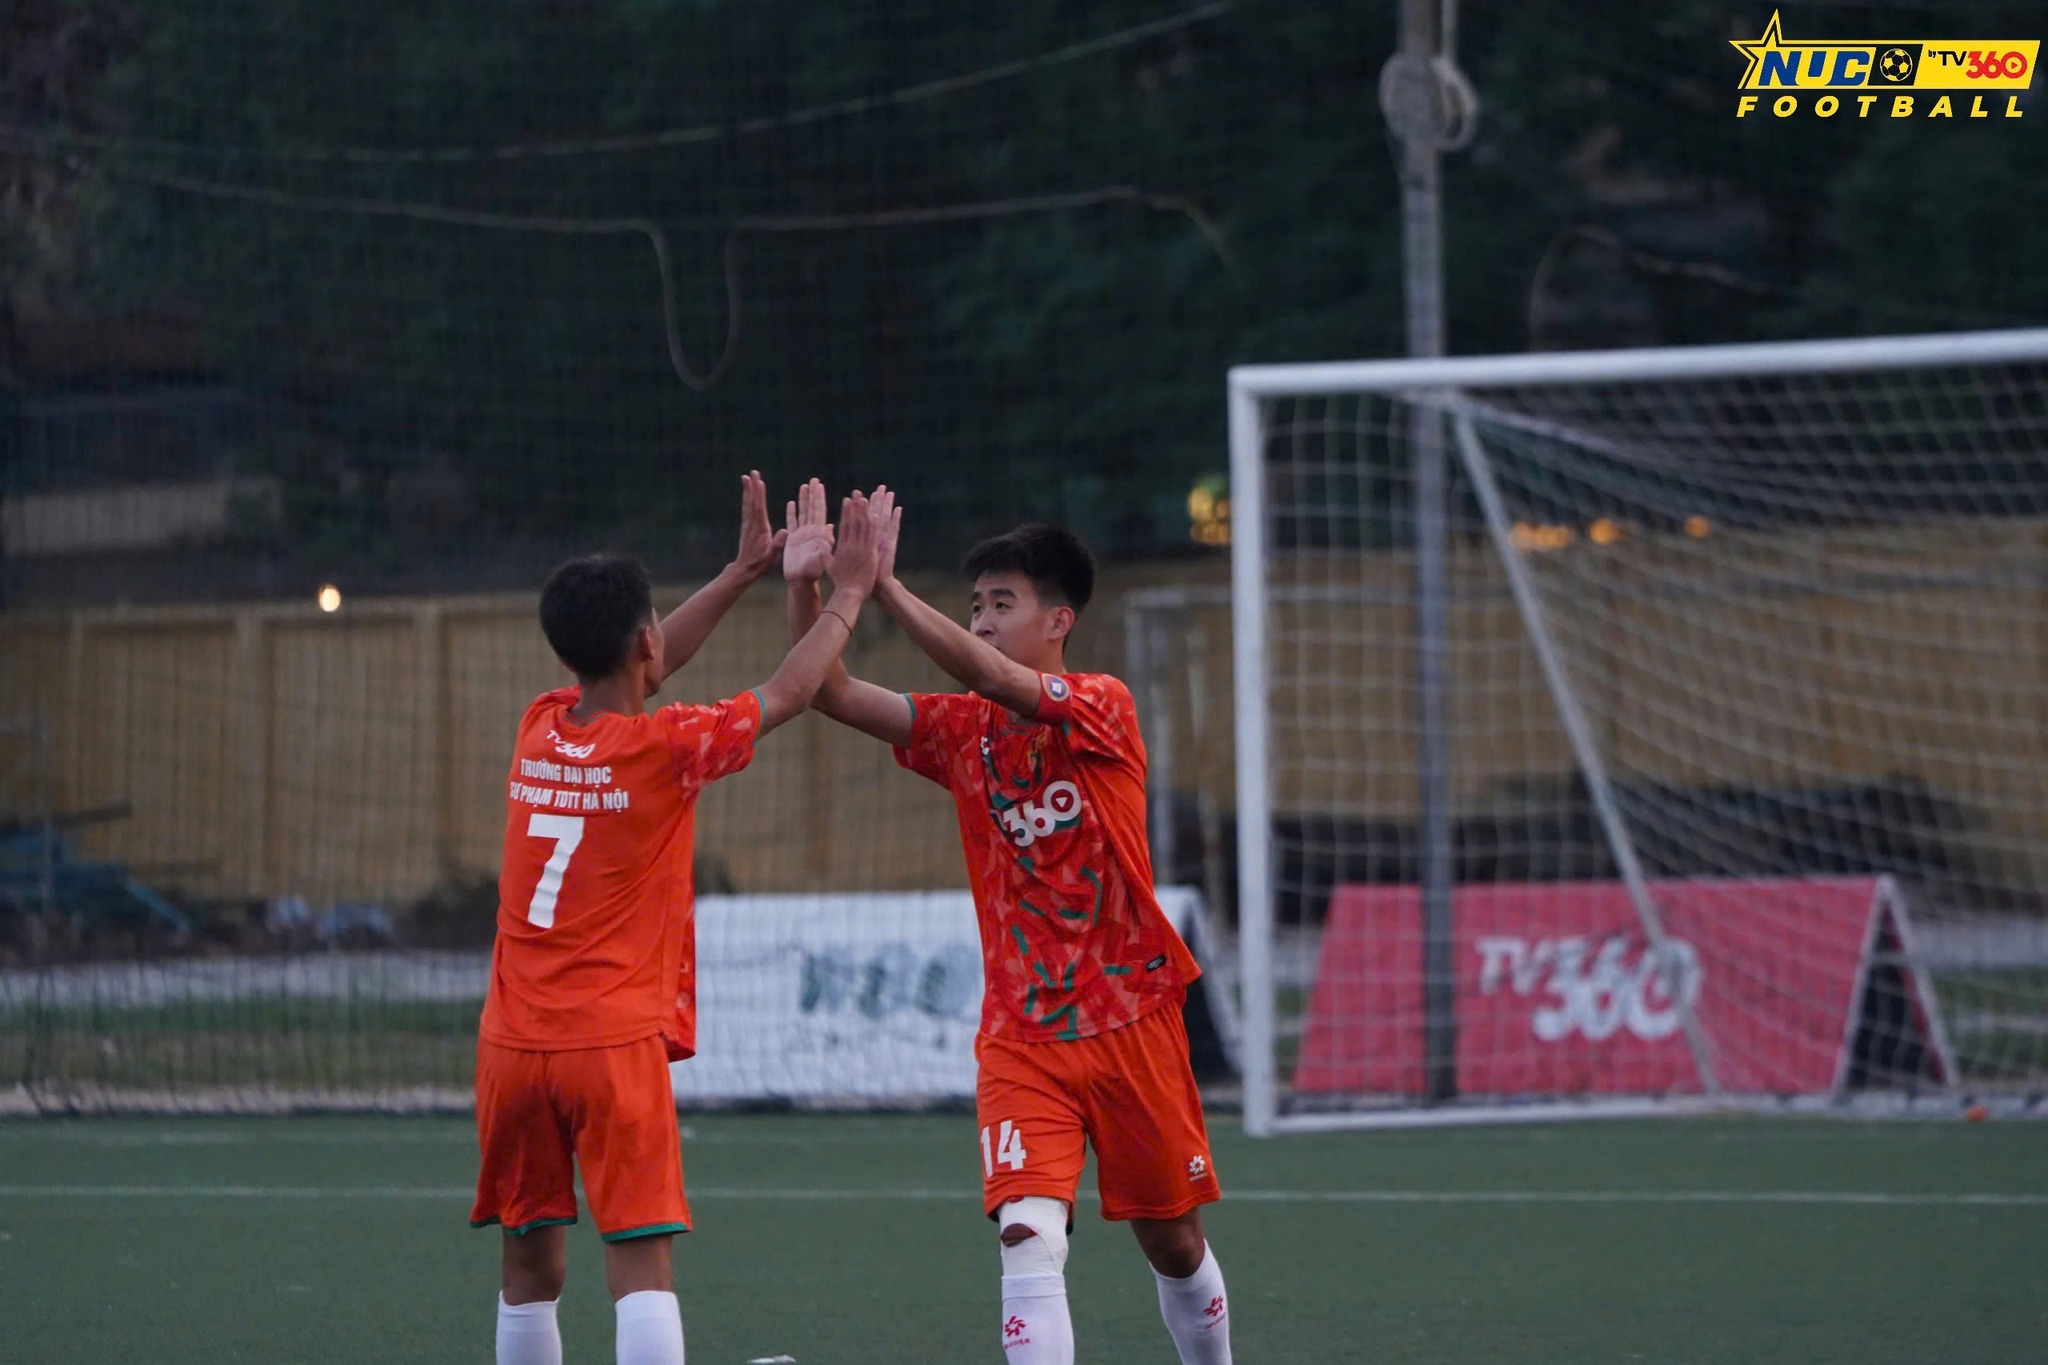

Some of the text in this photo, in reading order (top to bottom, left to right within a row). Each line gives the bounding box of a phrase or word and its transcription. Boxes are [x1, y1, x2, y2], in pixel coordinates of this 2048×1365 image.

[520, 785, 553, 807] PHẠM
[554, 789, 580, 809] TDTT
[582, 790, 599, 810] HÀ
[602, 788, 629, 813] NỘI
[584, 766, 612, 788] HỌC
[989, 780, 1082, 847] 360
[527, 813, 585, 929] 7
[980, 1120, 1027, 1178] 14
